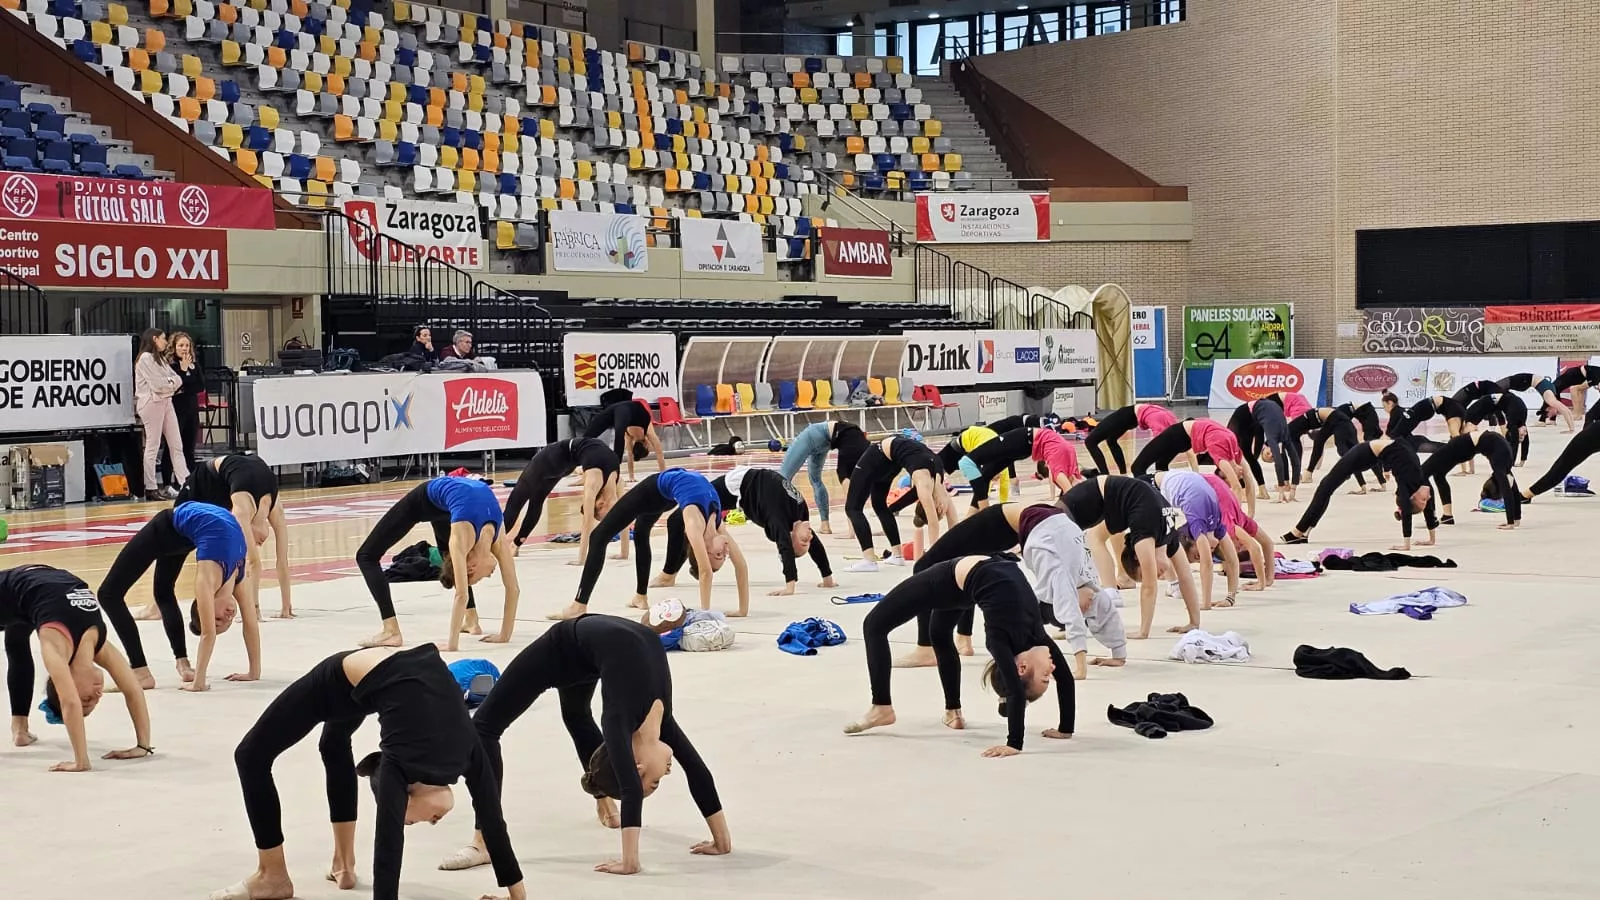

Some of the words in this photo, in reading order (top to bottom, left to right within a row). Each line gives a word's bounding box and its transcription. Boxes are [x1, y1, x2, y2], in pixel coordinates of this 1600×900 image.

[74, 181, 163, 197] DIVISIÓN
[74, 192, 129, 223] FÚTBOL
[131, 197, 166, 224] SALA
[960, 204, 1020, 220] Zaragoza
[385, 203, 477, 239] Zaragoza
[0, 227, 39, 241] Centro
[55, 243, 157, 279] SIGLO
[166, 248, 219, 281] XXI
[389, 239, 478, 265] DEPORTE
[838, 242, 888, 265] AMBAR
[1190, 308, 1231, 322] PANELES
[1232, 307, 1276, 321] SOLARES
[1261, 322, 1285, 331] AHORRA
[1367, 315, 1483, 341] COLOQUIO
[598, 352, 660, 371] GOBIERNO
[907, 343, 971, 372] D-Link
[1016, 351, 1039, 361] LACOR
[598, 373, 615, 389] DE
[619, 372, 669, 388] ARAGON
[1233, 374, 1298, 388] ROMERO
[32, 383, 121, 409] ARAGON
[452, 386, 509, 420] Aldelis
[260, 388, 414, 444] wanapix
[455, 426, 483, 434] ALIMENTOS
[483, 425, 511, 433] DELICIOSOS
